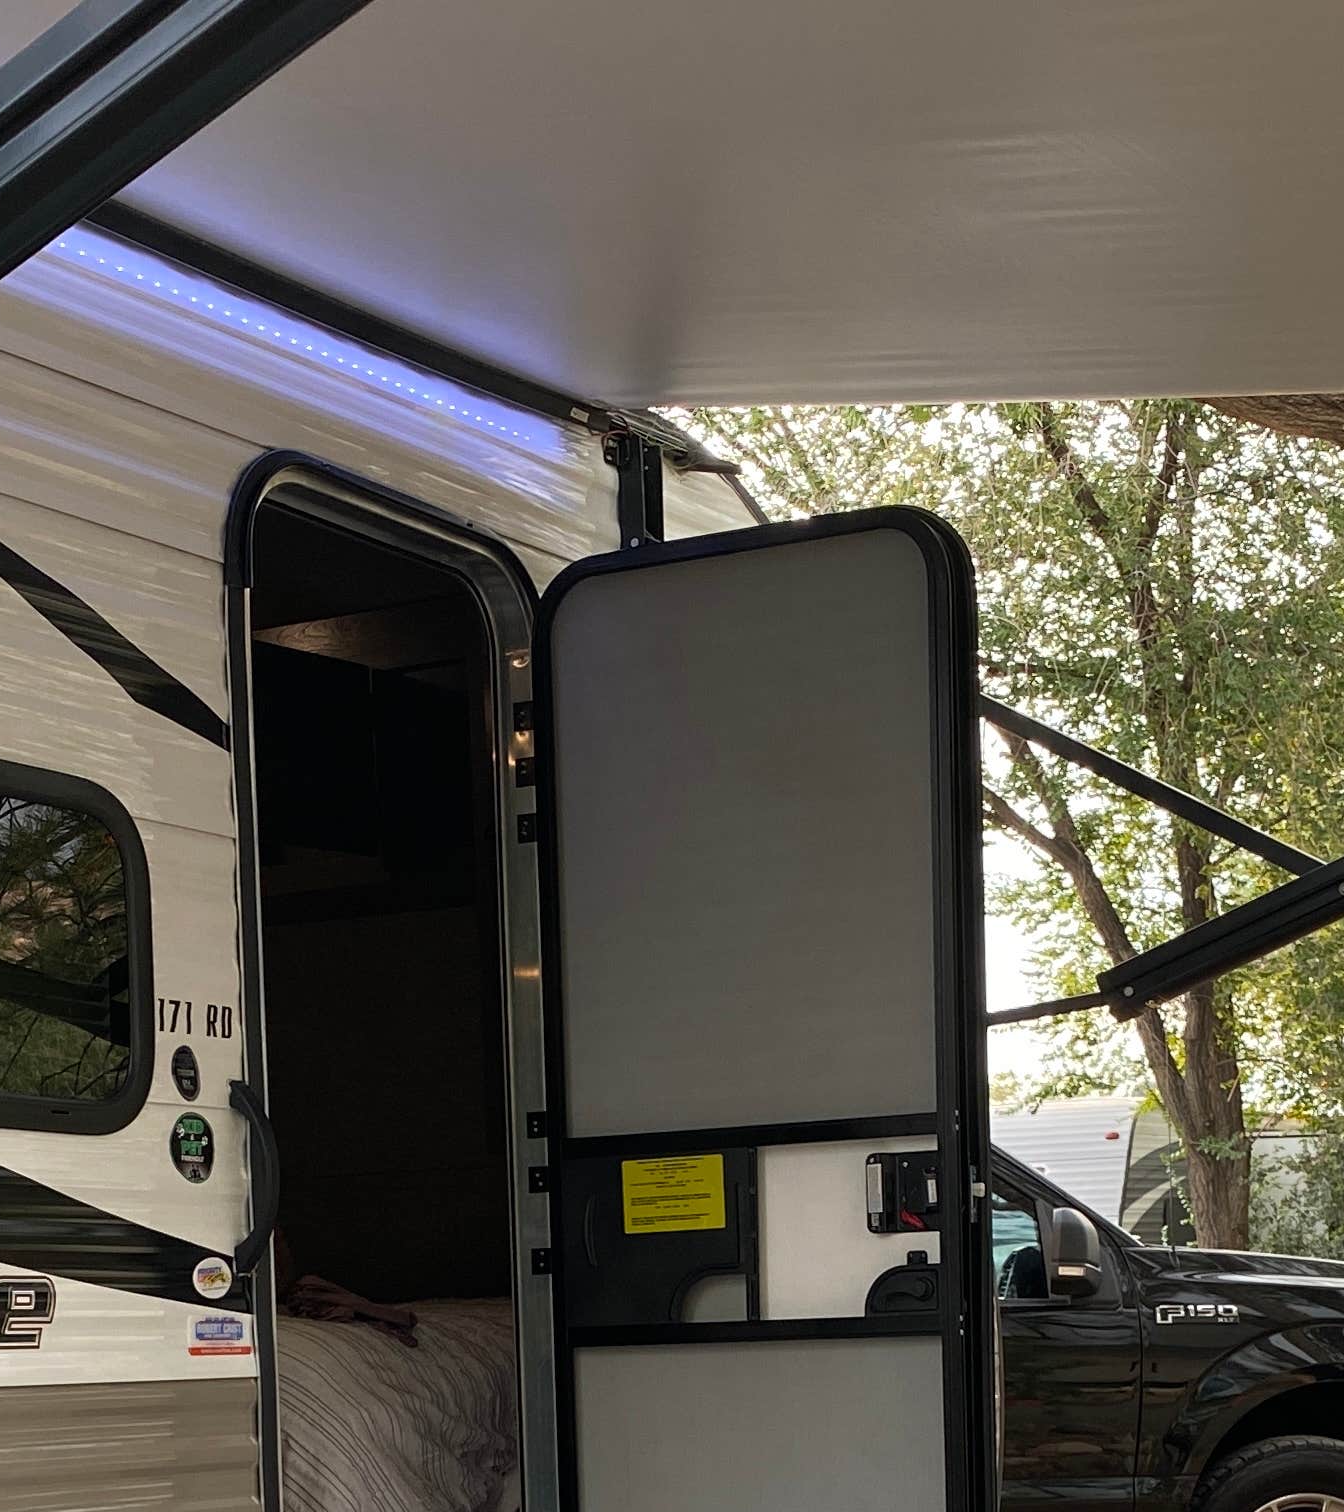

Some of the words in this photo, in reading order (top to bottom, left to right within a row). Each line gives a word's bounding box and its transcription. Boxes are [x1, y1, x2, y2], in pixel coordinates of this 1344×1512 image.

[158, 998, 192, 1034] 171
[206, 1004, 232, 1038] RD
[180, 1140, 202, 1156] PET
